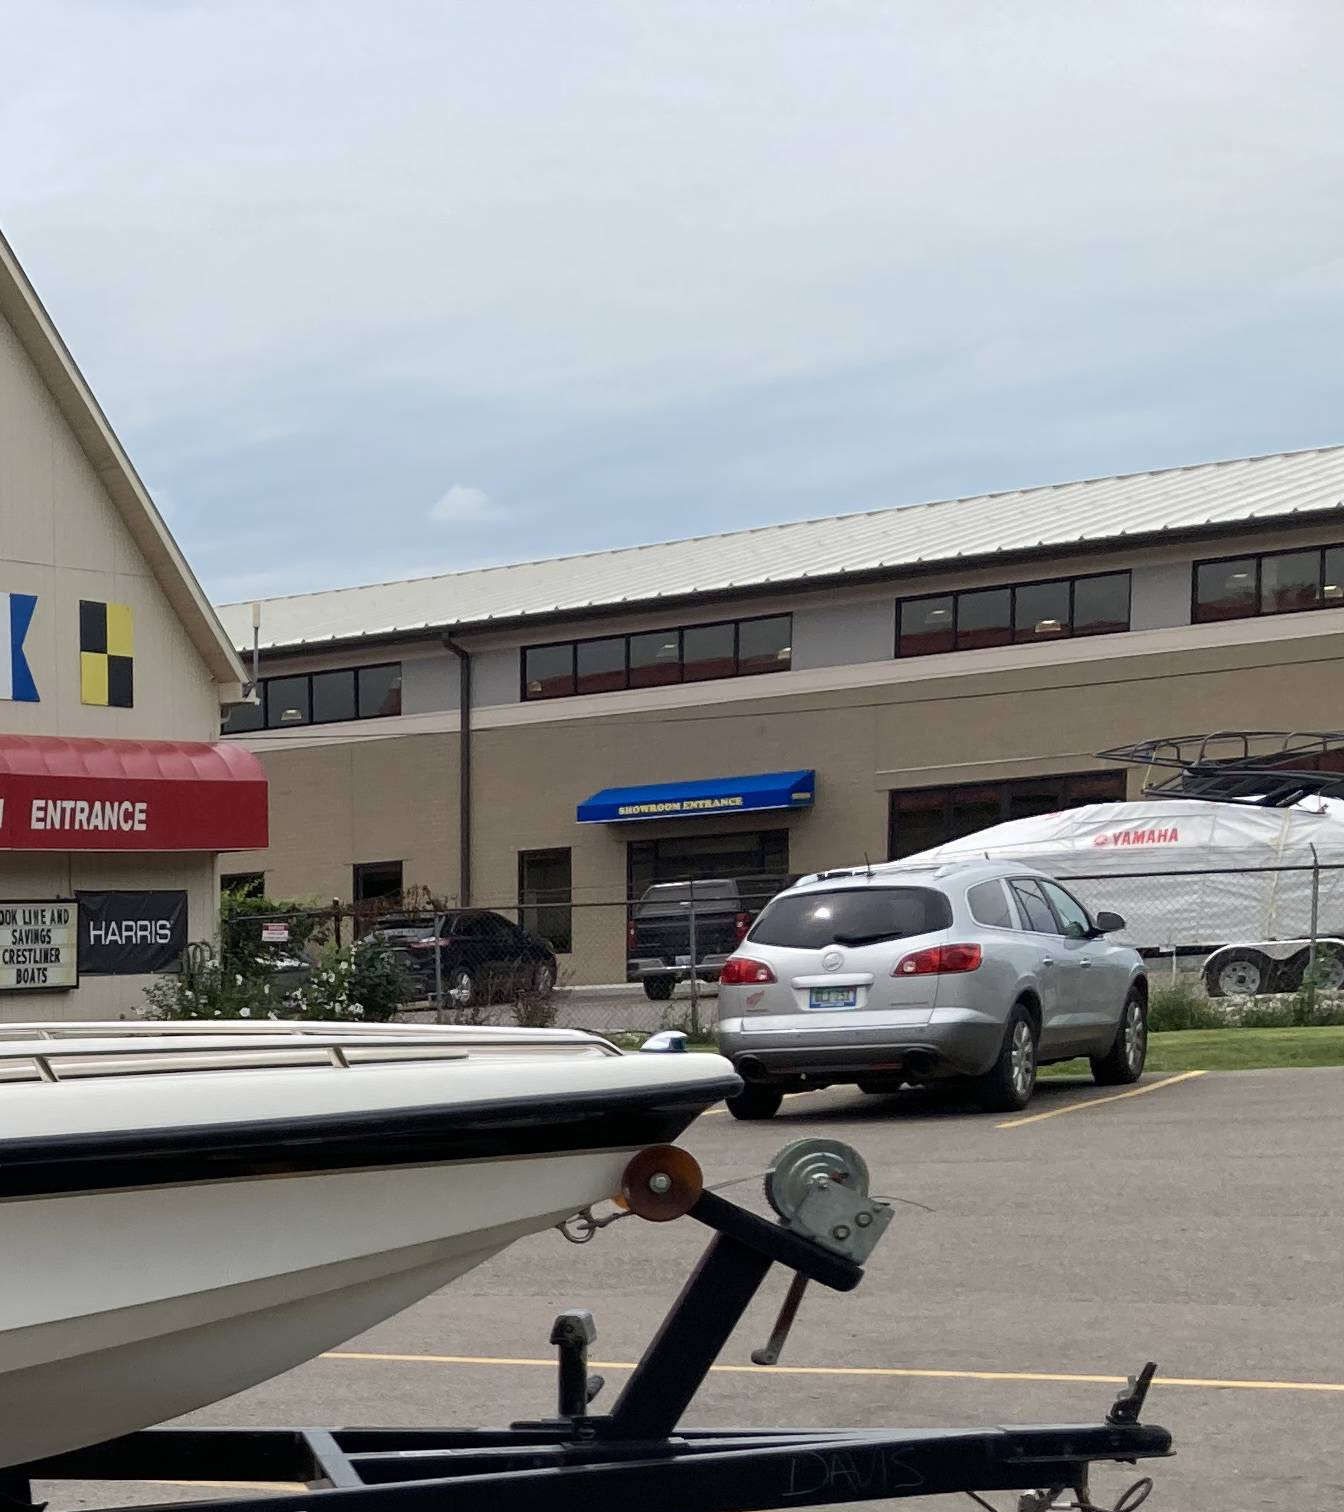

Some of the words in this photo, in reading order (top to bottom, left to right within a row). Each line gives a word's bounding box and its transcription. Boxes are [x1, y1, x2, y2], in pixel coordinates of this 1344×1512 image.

[30, 799, 148, 831] ENTRANCE
[618, 803, 681, 815] SHOWROOM
[682, 797, 743, 810] ENTRANCE
[1112, 828, 1179, 846] YAMAHA
[23, 909, 46, 925] LINE
[50, 908, 69, 925] AND
[11, 929, 52, 946] SAVINGS
[89, 920, 171, 945] HARRIS
[2, 947, 61, 965] CRESTLINER
[16, 967, 48, 985] BOATS
